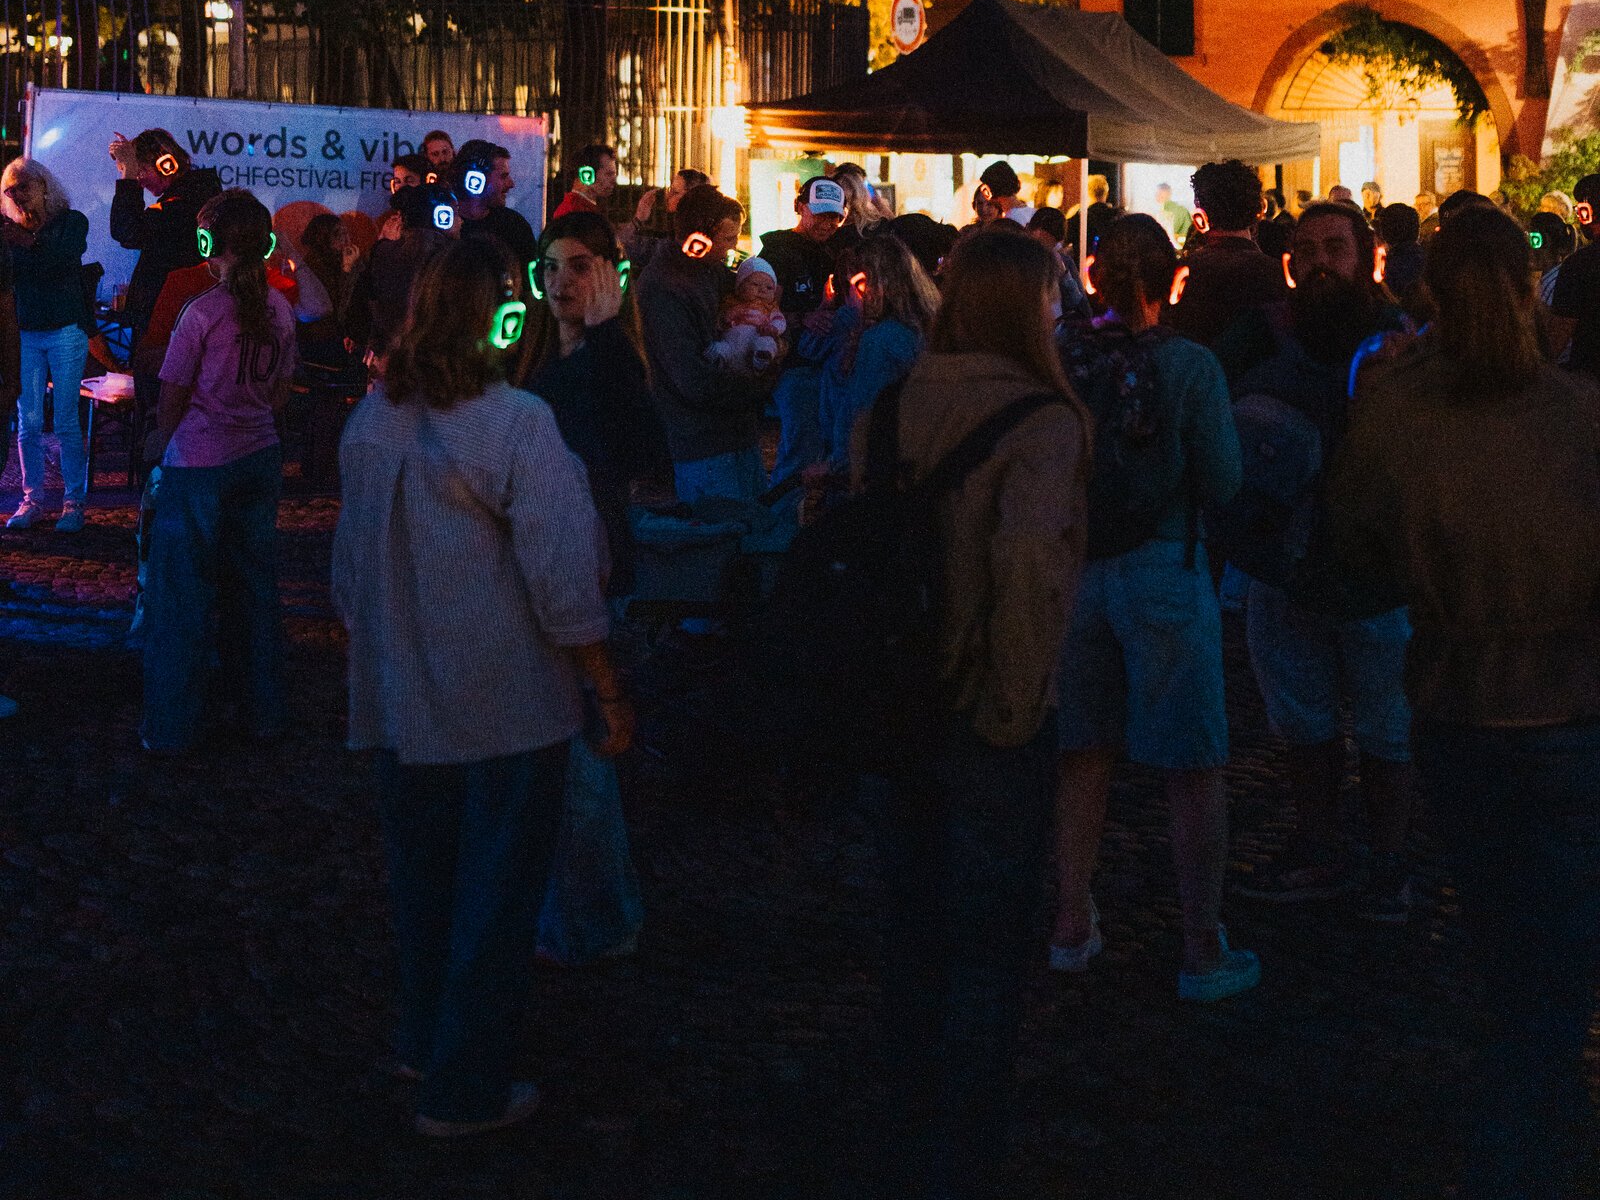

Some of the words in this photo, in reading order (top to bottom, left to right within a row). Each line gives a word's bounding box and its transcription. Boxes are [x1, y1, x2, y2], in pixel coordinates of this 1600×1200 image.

[187, 126, 307, 158] words
[321, 129, 346, 160] &
[359, 132, 424, 162] vib
[235, 333, 280, 384] 10
